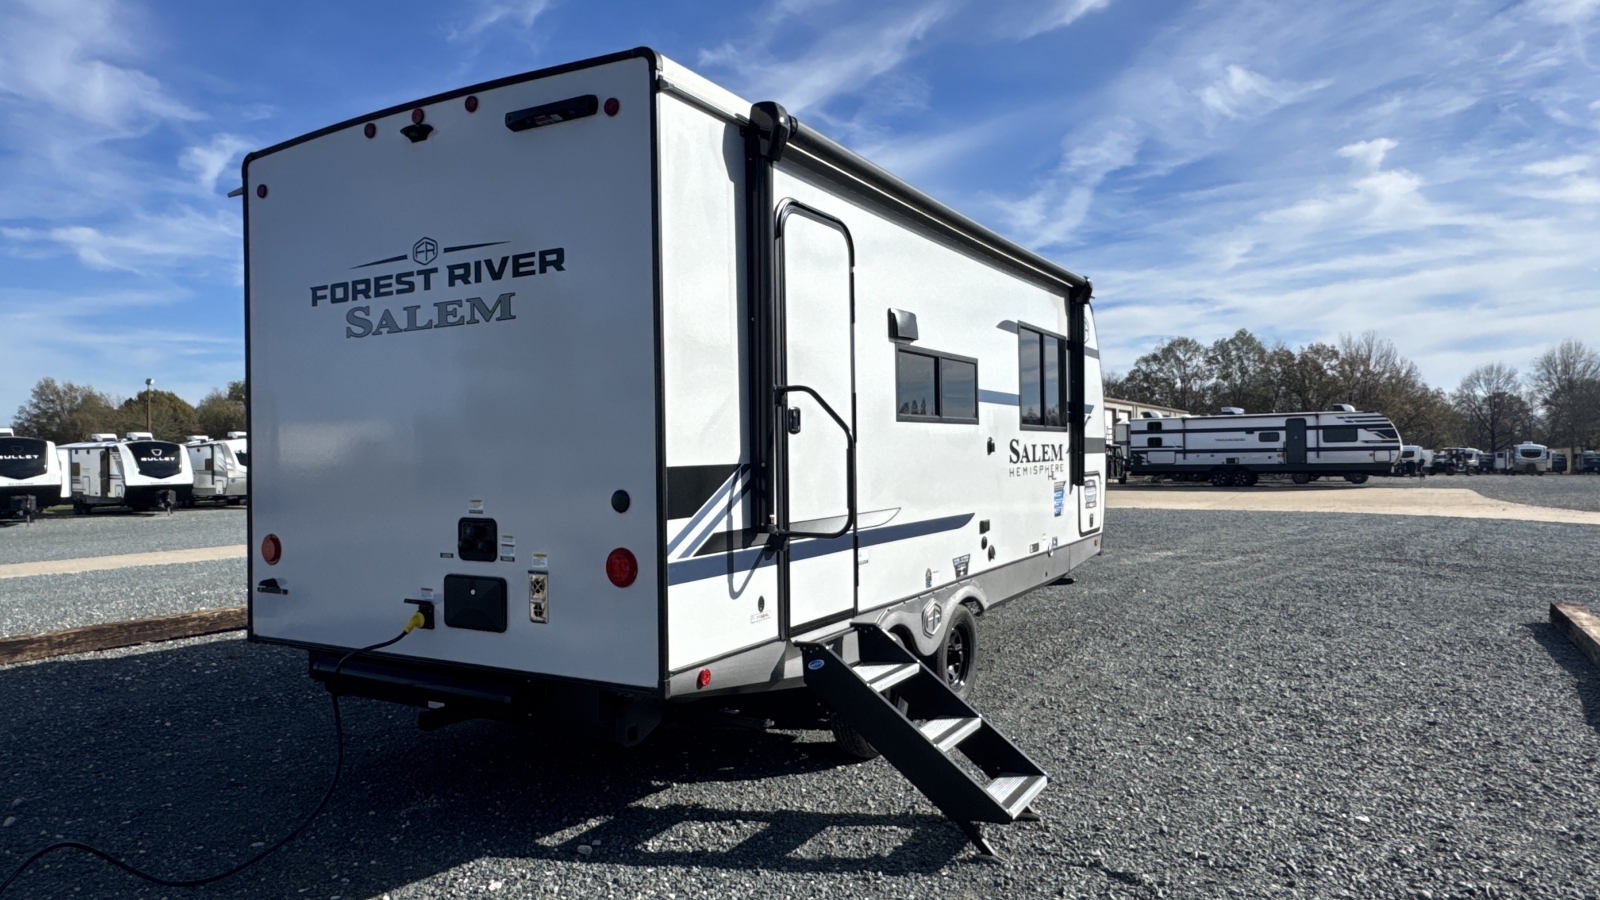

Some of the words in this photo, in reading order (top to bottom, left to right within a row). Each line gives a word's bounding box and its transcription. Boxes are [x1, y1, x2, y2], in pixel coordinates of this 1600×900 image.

[310, 267, 439, 307] FOREST
[446, 247, 566, 288] RIVER
[346, 292, 516, 339] SALEM
[1009, 438, 1064, 464] SALEM
[1009, 463, 1064, 478] HEMISPHERE
